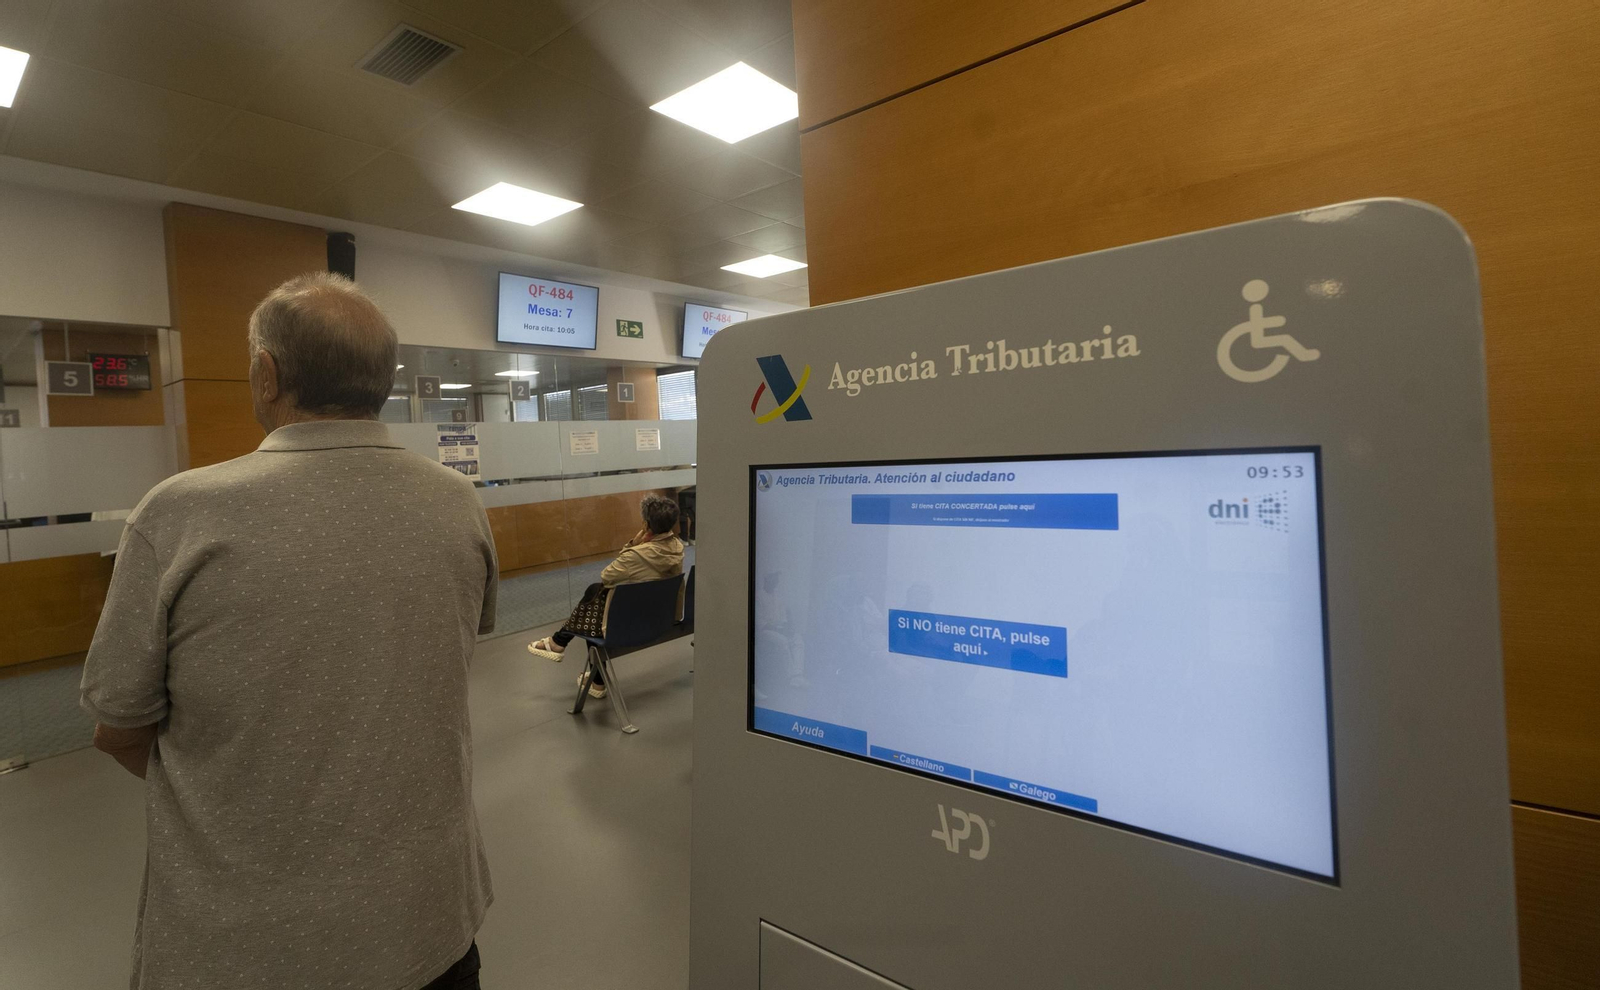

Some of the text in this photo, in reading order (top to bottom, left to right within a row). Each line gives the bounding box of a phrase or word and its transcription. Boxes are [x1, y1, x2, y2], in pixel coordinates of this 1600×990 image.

[528, 284, 574, 300] QF-484
[528, 303, 573, 318] Mesa: 7
[703, 310, 732, 323] QF-484
[523, 323, 540, 331] Hora
[557, 326, 575, 335] 10:05
[828, 324, 1141, 397] Agencia Tributaria
[63, 371, 78, 387] 5
[425, 382, 433, 394] 3
[517, 385, 525, 397] 2
[622, 387, 629, 398] 1
[456, 412, 462, 420] 9
[776, 470, 1016, 487] Agencia Tributaria. Atención al ciudadano
[1247, 465, 1304, 479] 09:53
[934, 502, 950, 510] CITA
[950, 502, 998, 510] CONCERTADA
[998, 503, 1019, 511] pulse
[1208, 497, 1249, 519] dni
[898, 616, 1050, 646] Si NO tiene CITA, pulse
[953, 642, 982, 656] aquí
[791, 721, 825, 739] Ayuda
[899, 754, 945, 773] Castellano
[1018, 782, 1057, 801] Galego
